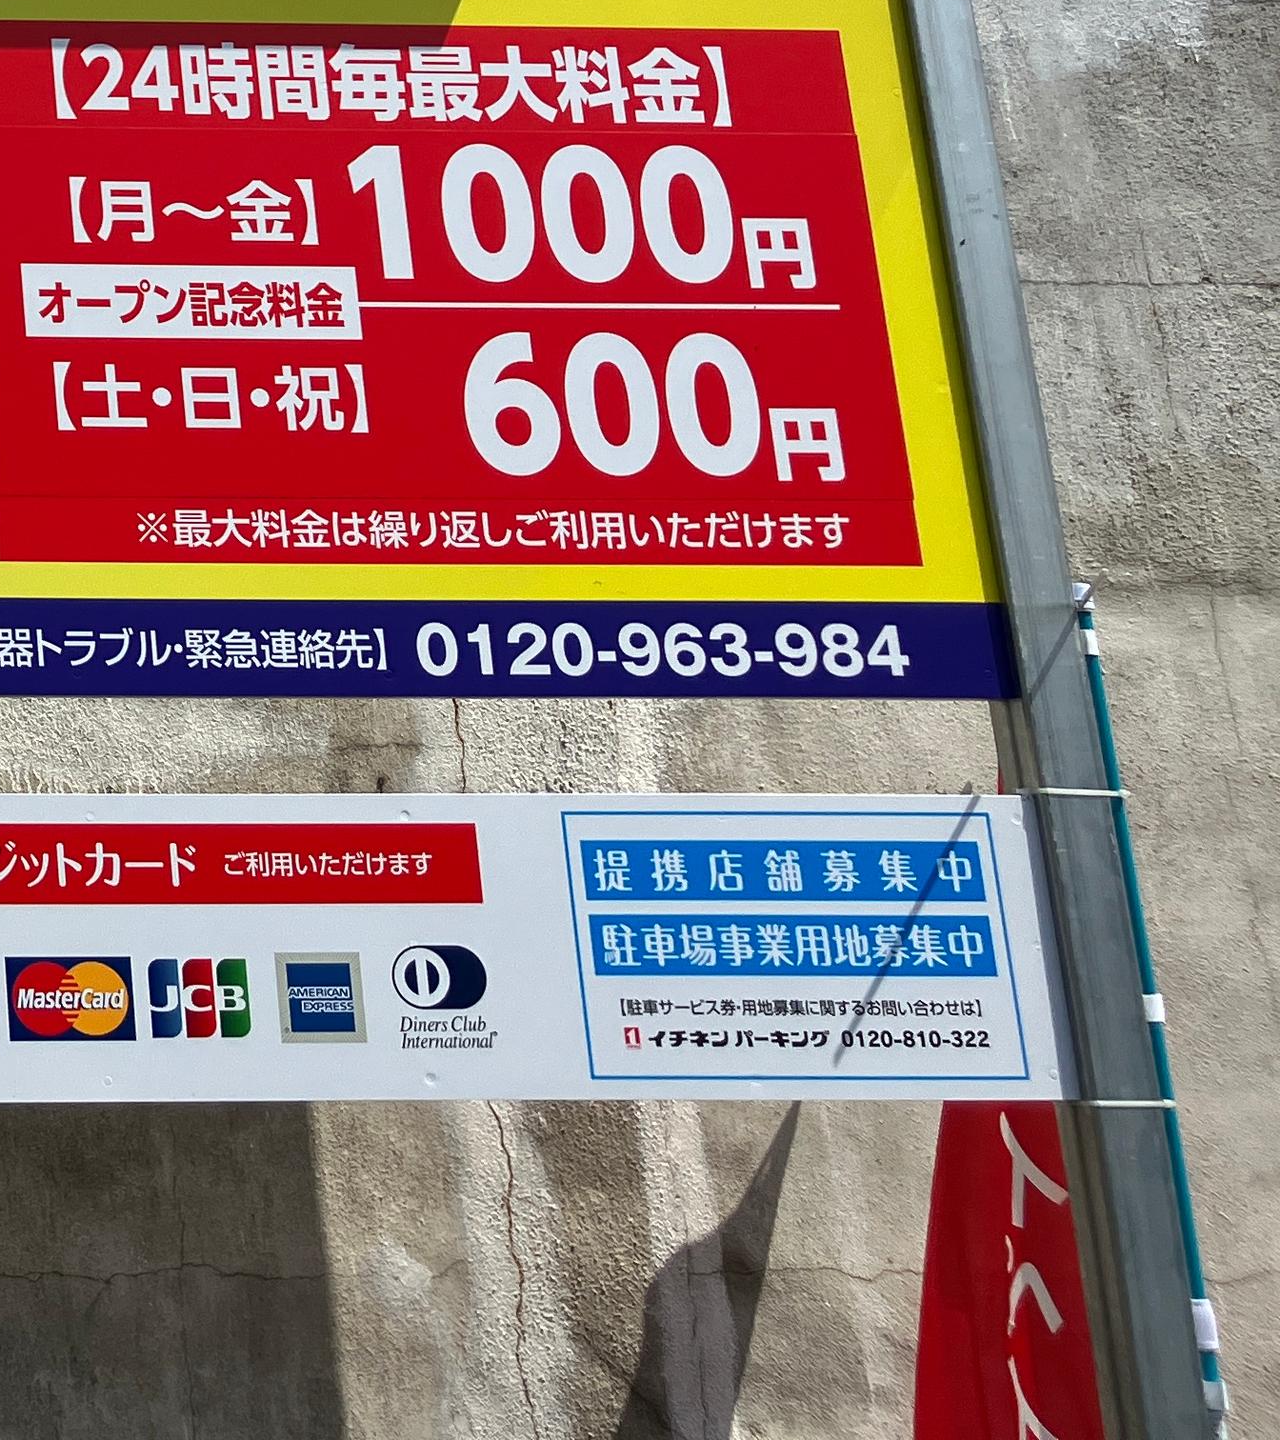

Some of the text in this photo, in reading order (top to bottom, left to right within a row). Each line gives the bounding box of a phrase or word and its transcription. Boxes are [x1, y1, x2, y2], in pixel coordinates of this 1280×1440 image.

[51, 37, 731, 128] 【24時間毎最大料金】
[346, 142, 817, 290] 1000円
[38, 279, 347, 331] オープン記念料金
[463, 331, 845, 482] 600円
[135, 510, 850, 551] ※最大料金は繰り返しご利用いただけます
[416, 621, 910, 679] 0120-963-984
[223, 851, 433, 878] ご利用いただけます
[592, 848, 973, 893] 提携店舗募集中
[602, 923, 985, 968] 駐車場事業用地募集中
[16, 987, 125, 1012] MasterCard
[150, 984, 248, 1013] JCB
[289, 986, 352, 999] AMERICAN
[303, 1000, 355, 1013] EXPRESS
[400, 1016, 488, 1034] Diners Club
[401, 1031, 498, 1050] International
[841, 1029, 991, 1048] 0120-810-322
